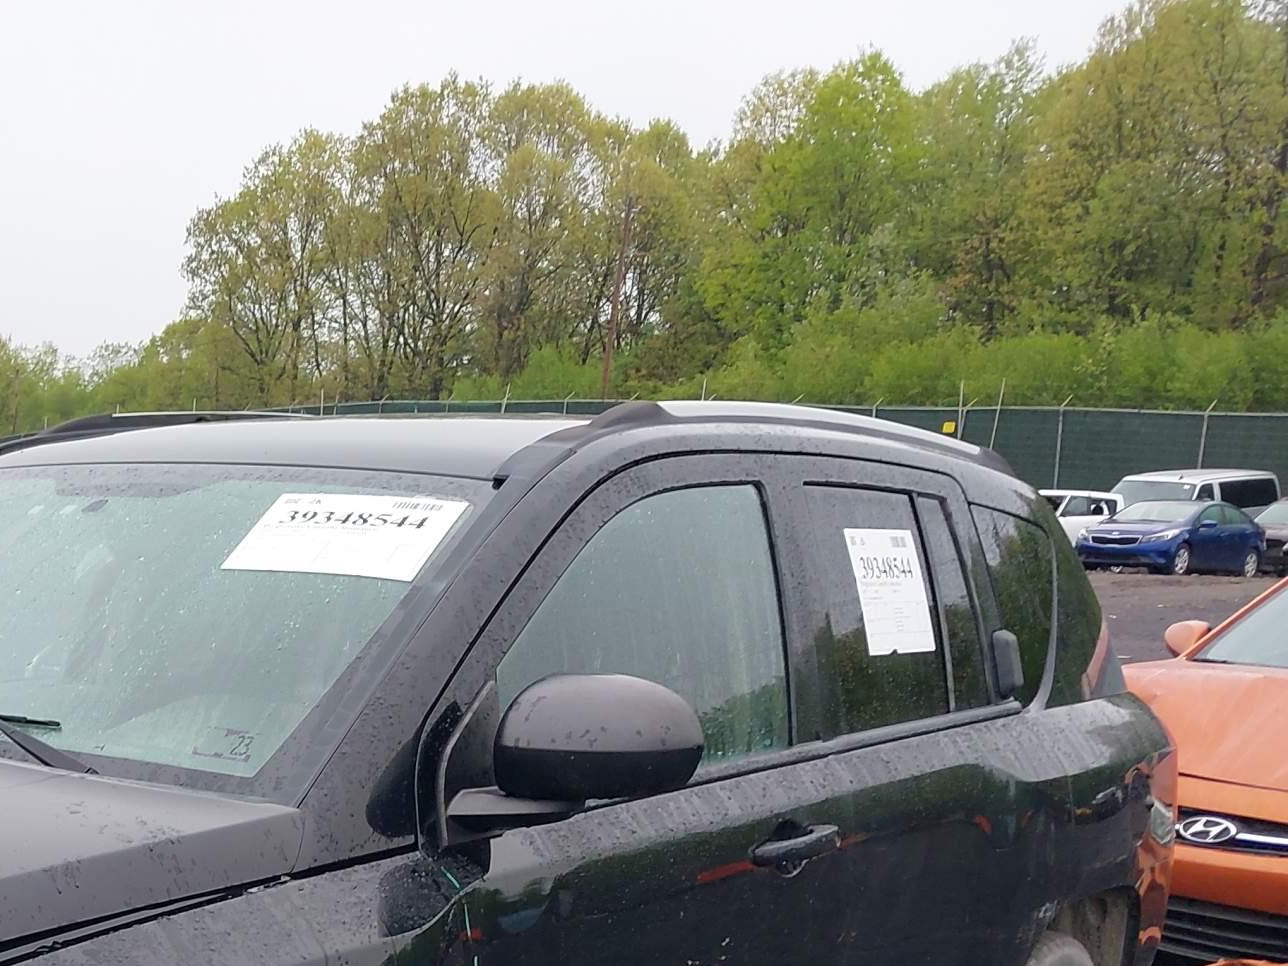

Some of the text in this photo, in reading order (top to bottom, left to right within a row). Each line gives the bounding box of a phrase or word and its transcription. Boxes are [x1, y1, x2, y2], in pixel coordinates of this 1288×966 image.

[278, 510, 429, 530] 39348544
[859, 556, 914, 580] 39348544
[229, 735, 255, 756] 23
